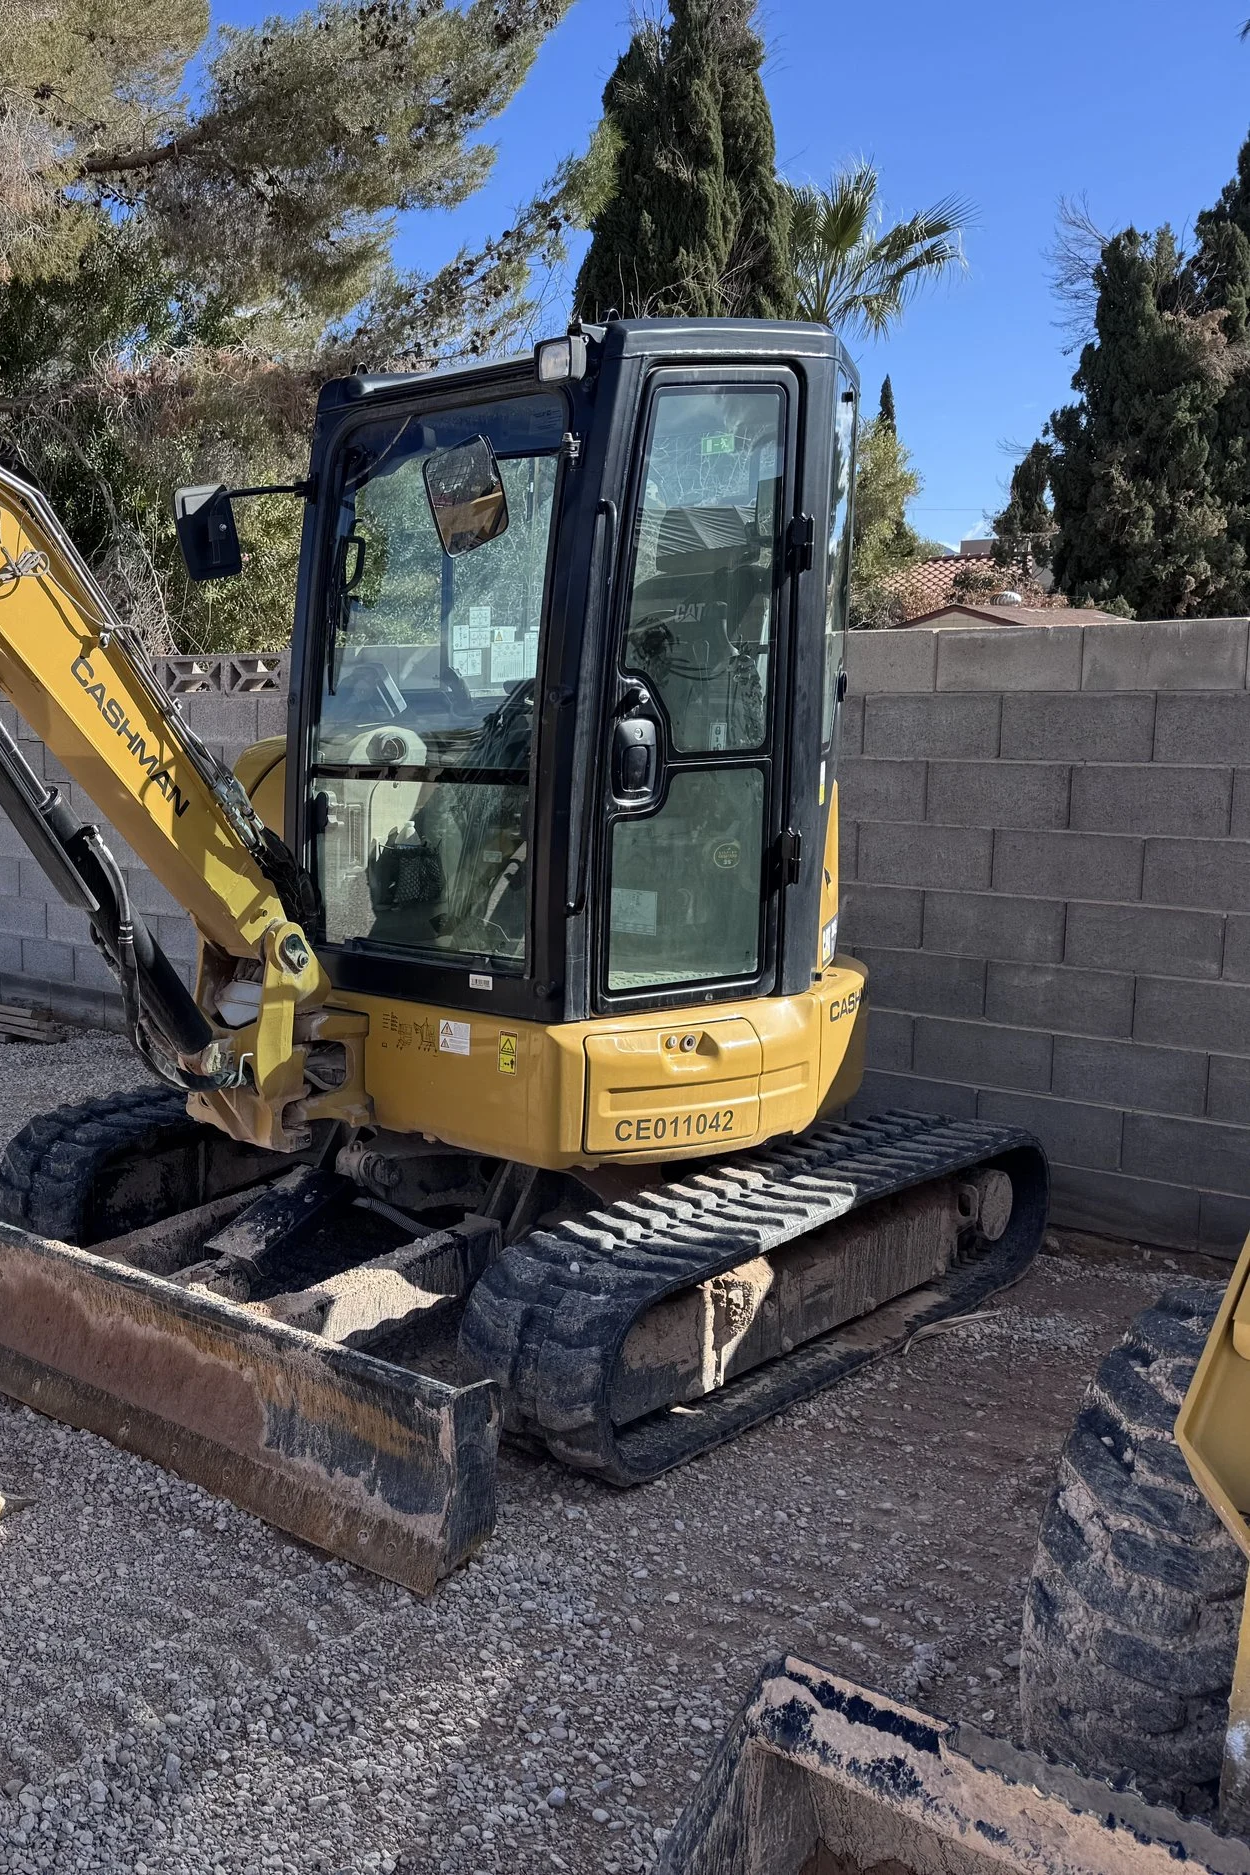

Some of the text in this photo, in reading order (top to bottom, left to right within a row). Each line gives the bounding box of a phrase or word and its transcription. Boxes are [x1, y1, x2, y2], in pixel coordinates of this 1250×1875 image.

[675, 602, 706, 623] CAT
[70, 656, 190, 818] CASHMAN
[614, 1109, 734, 1142] CE011042
